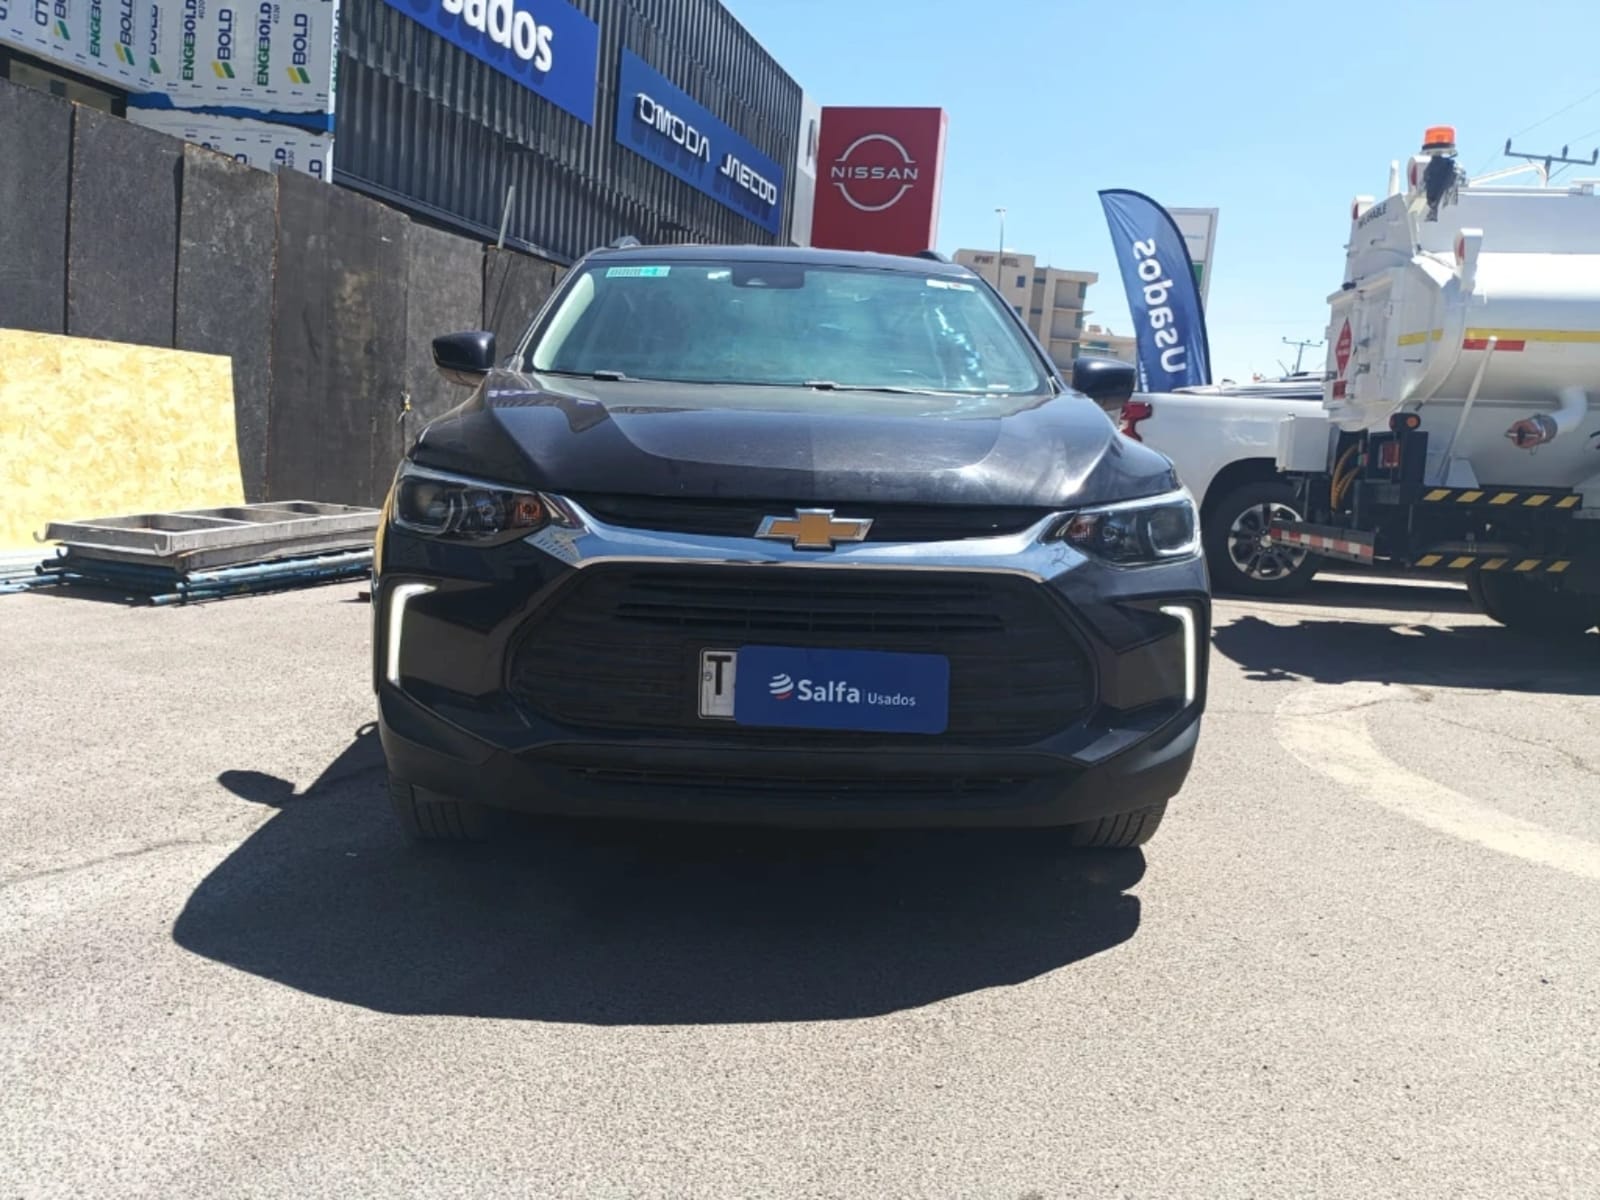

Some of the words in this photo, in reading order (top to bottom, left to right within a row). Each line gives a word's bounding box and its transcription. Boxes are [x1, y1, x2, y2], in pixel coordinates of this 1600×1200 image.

[217, 8, 232, 60] BOLD
[257, 2, 272, 87] ENGEBOLD
[292, 13, 308, 65] BOLD
[831, 166, 919, 180] NISSAN
[707, 655, 732, 696] T
[797, 679, 860, 704] Salfa
[867, 692, 916, 707] Usados
